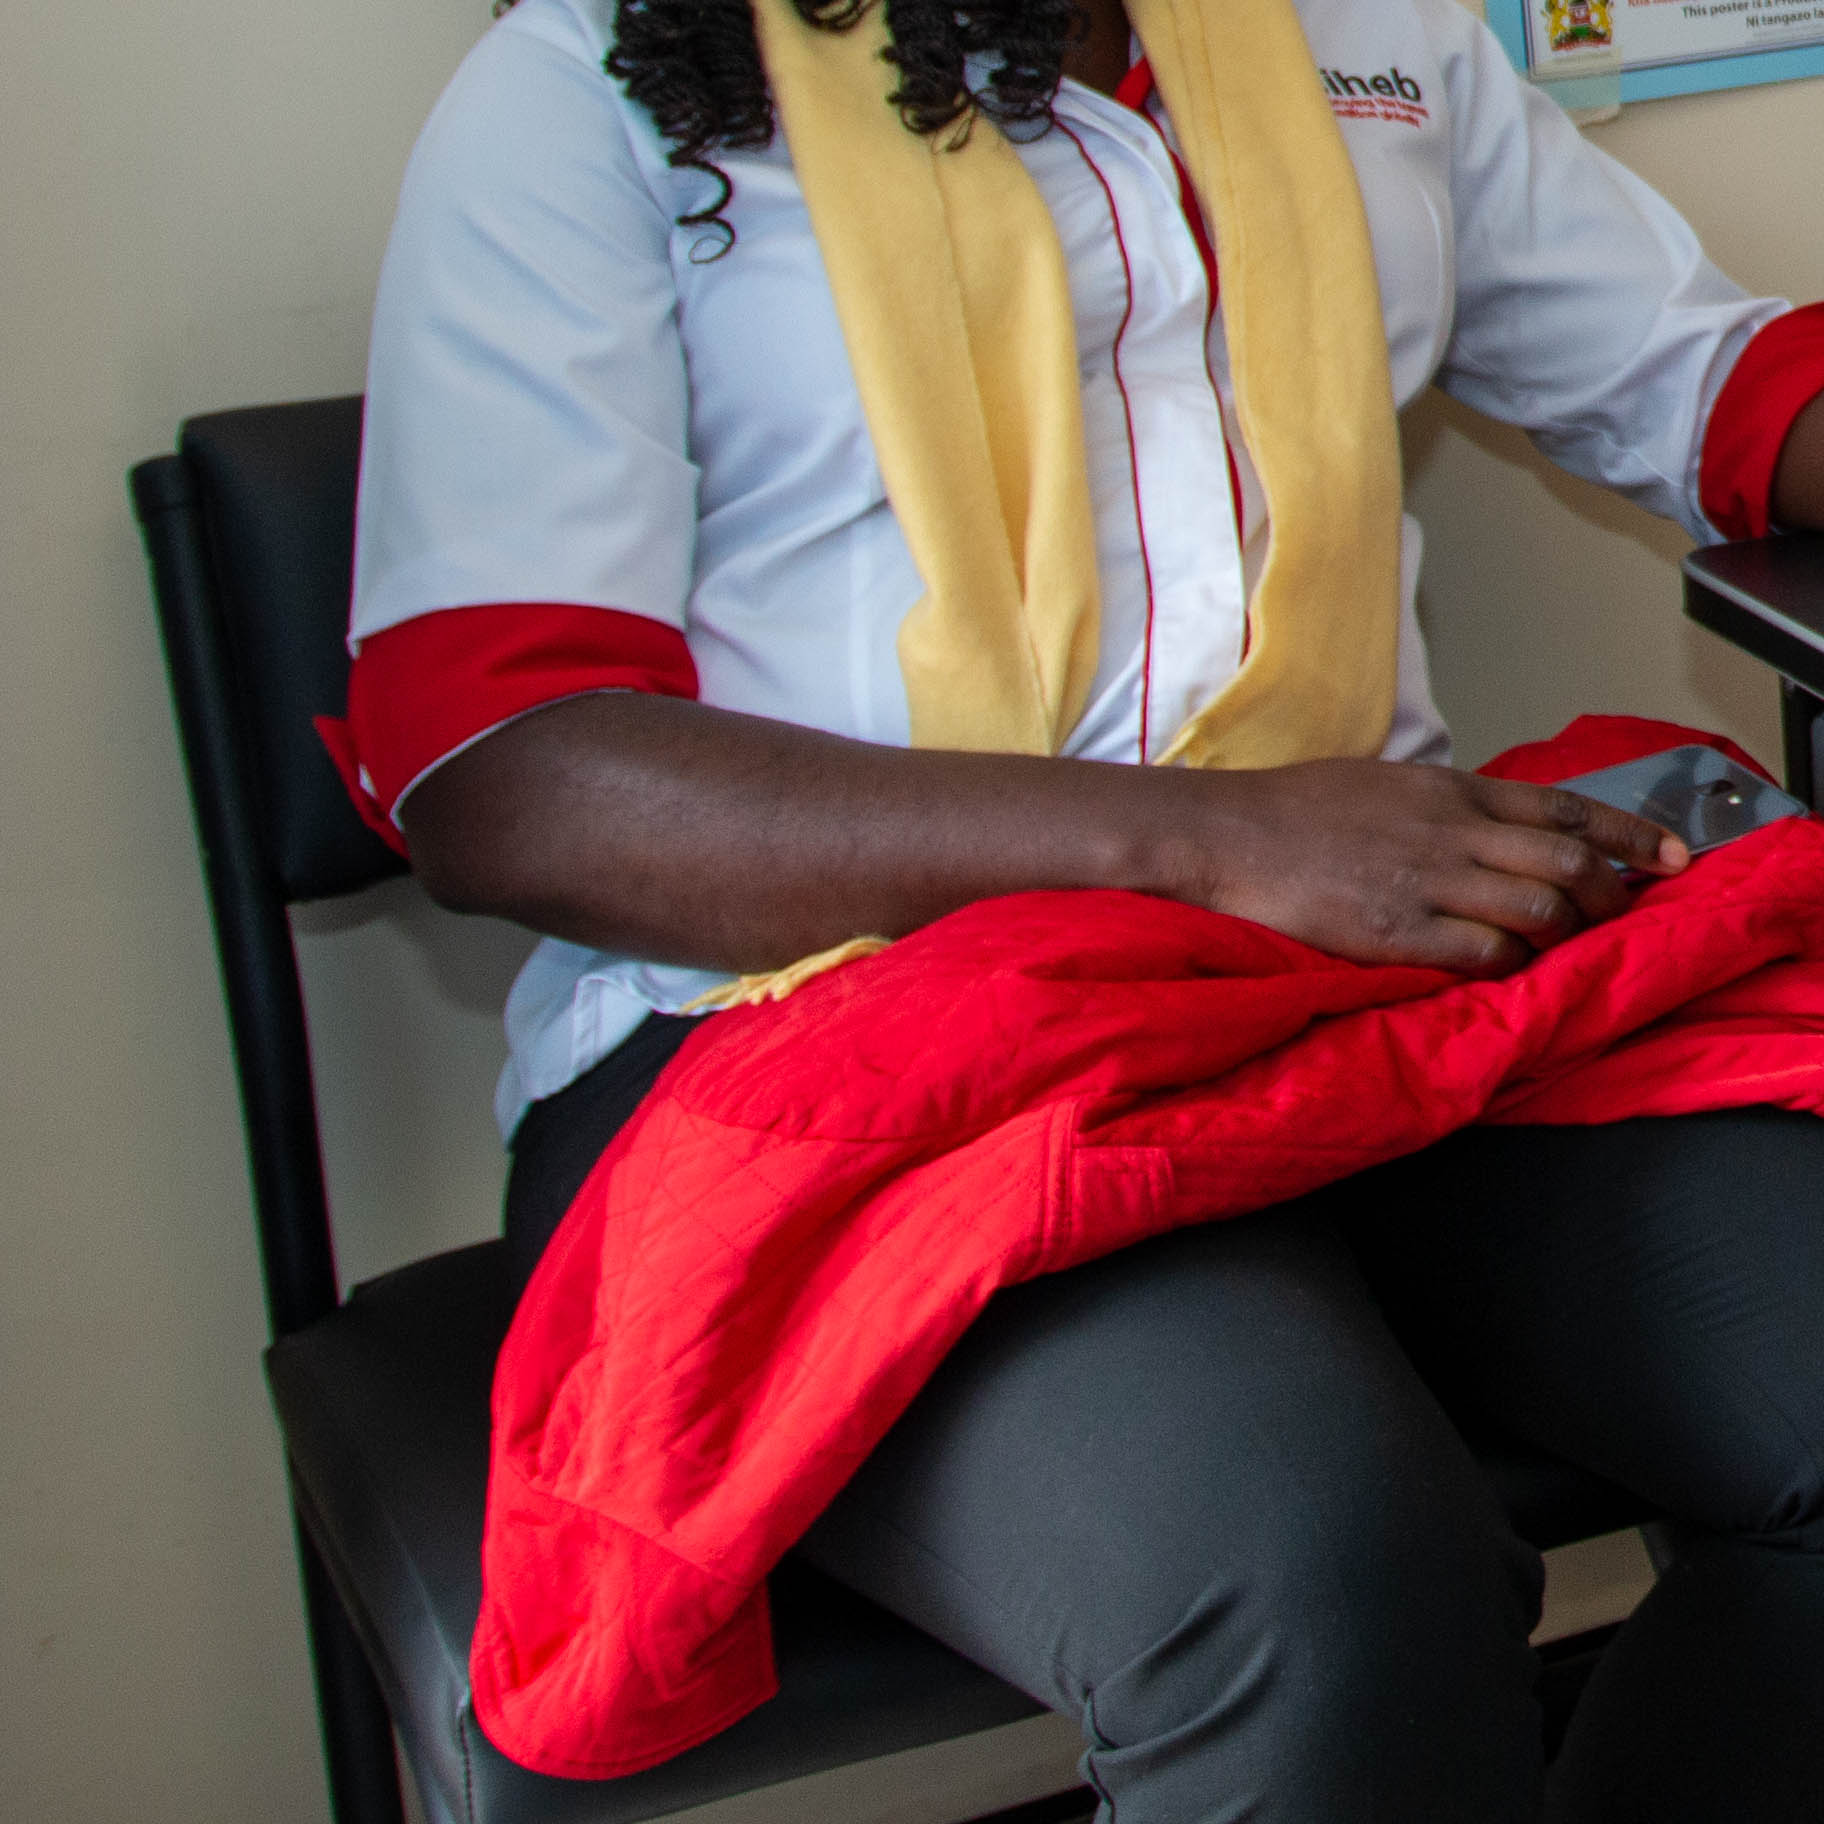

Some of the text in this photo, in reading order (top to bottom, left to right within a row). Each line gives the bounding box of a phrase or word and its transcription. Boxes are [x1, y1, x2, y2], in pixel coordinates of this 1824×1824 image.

[1682, 3, 1706, 18] This
[1710, 0, 1748, 16] poster
[1764, 0, 1772, 8] a
[1746, 14, 1759, 27] Ni
[1761, 9, 1810, 28] tangazo
[1813, 6, 1824, 19] la
[1320, 66, 1422, 103] iheb
